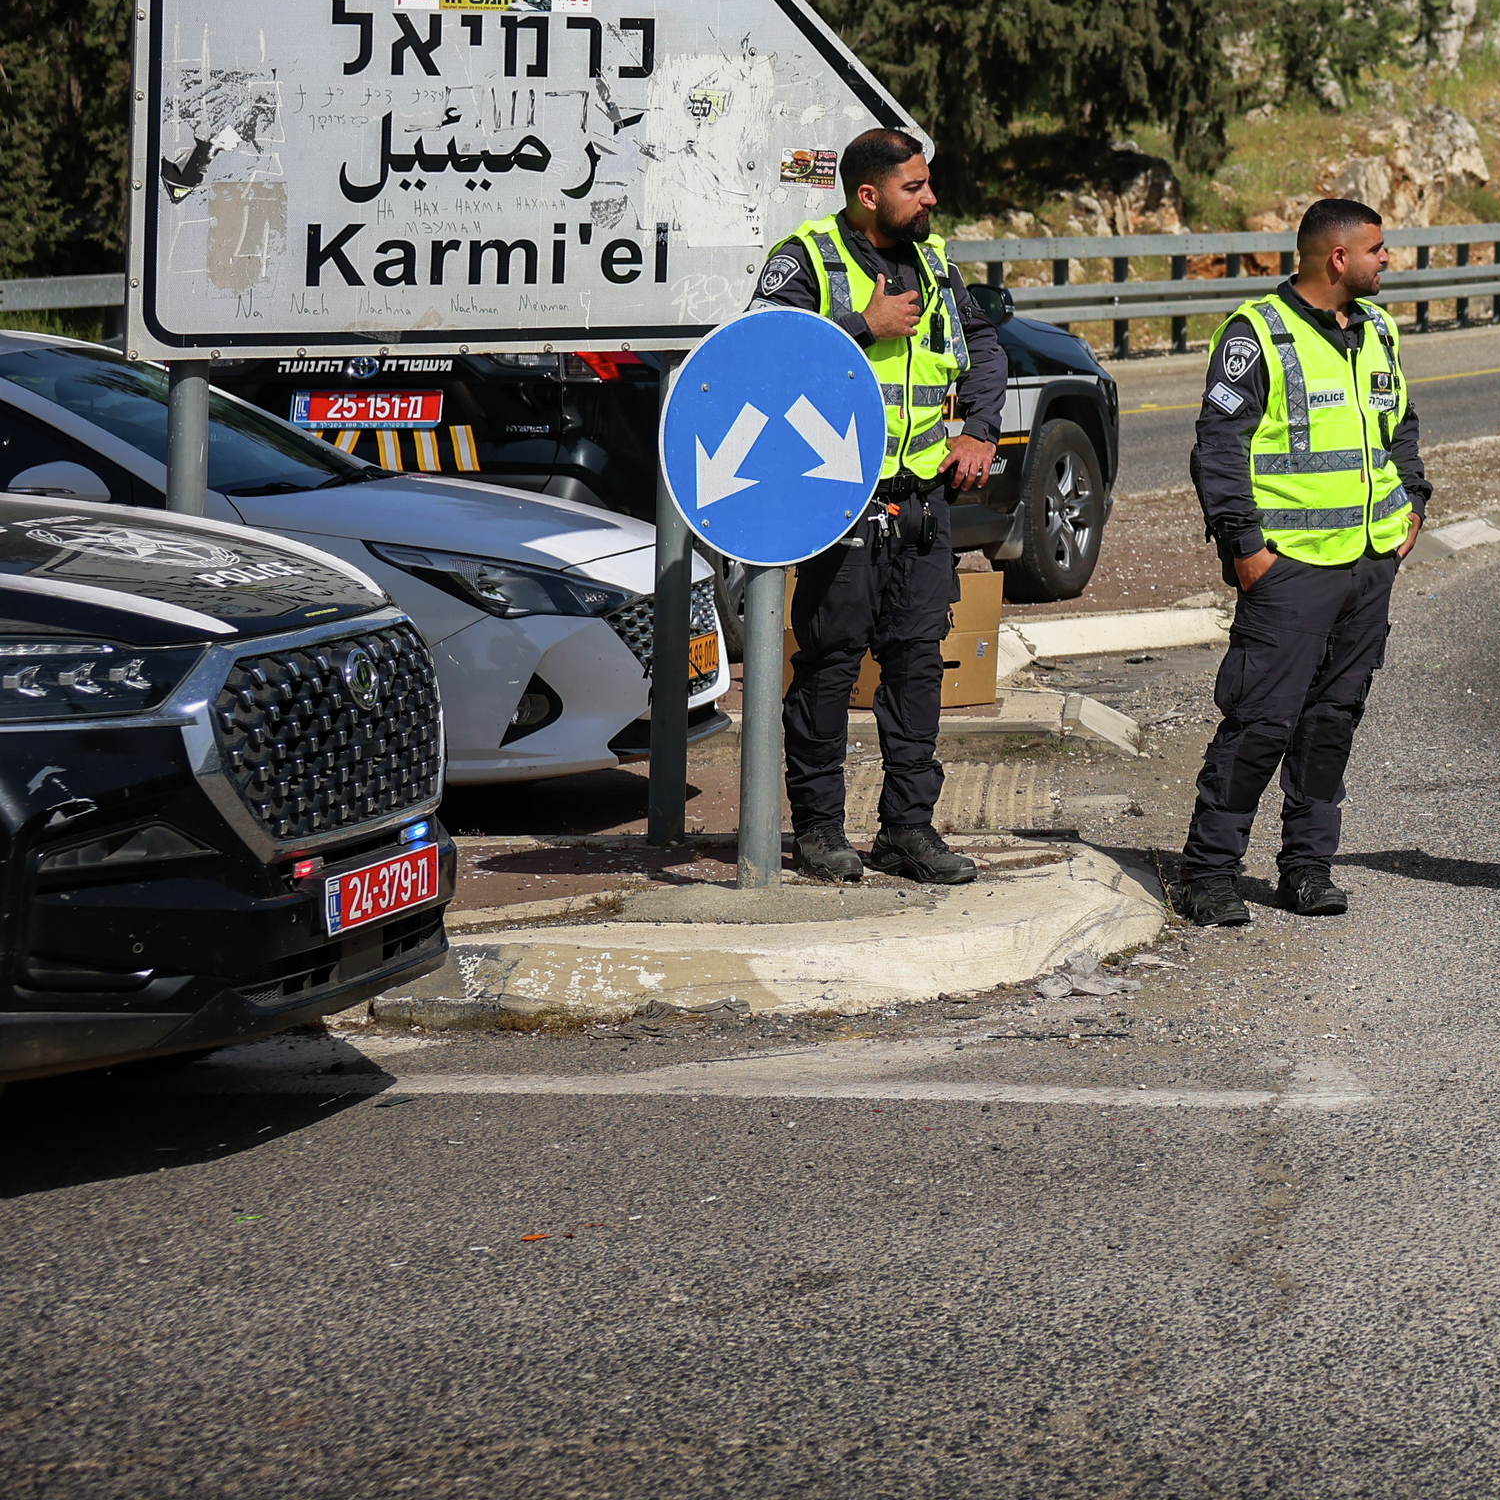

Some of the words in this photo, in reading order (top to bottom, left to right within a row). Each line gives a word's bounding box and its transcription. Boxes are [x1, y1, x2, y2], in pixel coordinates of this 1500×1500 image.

[306, 220, 669, 287] Karmi'el
[235, 288, 264, 319] Na
[290, 292, 330, 316] Nach
[277, 360, 344, 373] התנועה
[382, 359, 453, 373] משטרת
[1309, 391, 1345, 404] POLICE
[195, 562, 305, 589] POLICE
